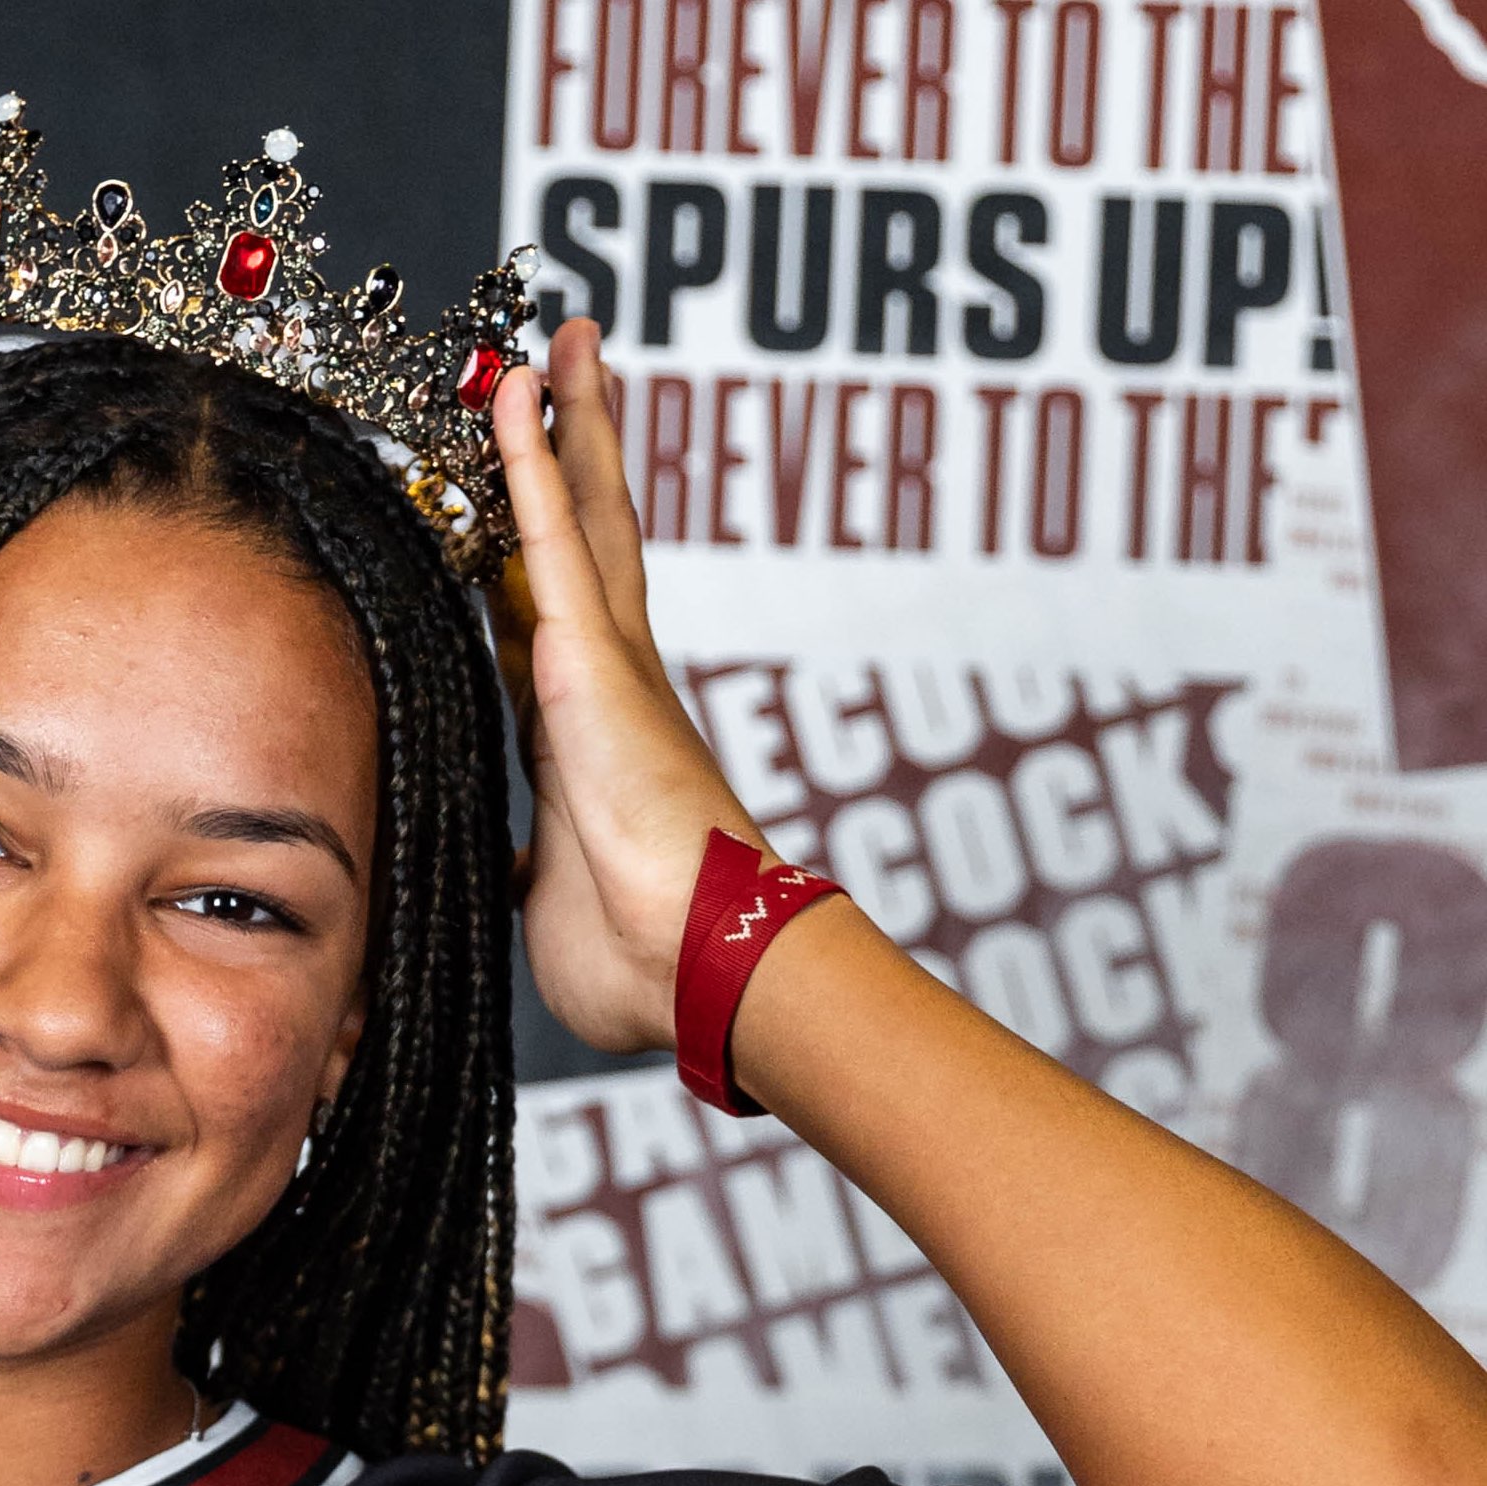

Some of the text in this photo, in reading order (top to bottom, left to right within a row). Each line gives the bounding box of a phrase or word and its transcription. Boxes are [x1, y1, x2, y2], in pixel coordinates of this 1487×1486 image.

[534, 0, 956, 162] FOREVER
[984, 0, 1100, 168] TO
[534, 176, 1049, 360] SPURS
[976, 386, 1084, 557] TO
